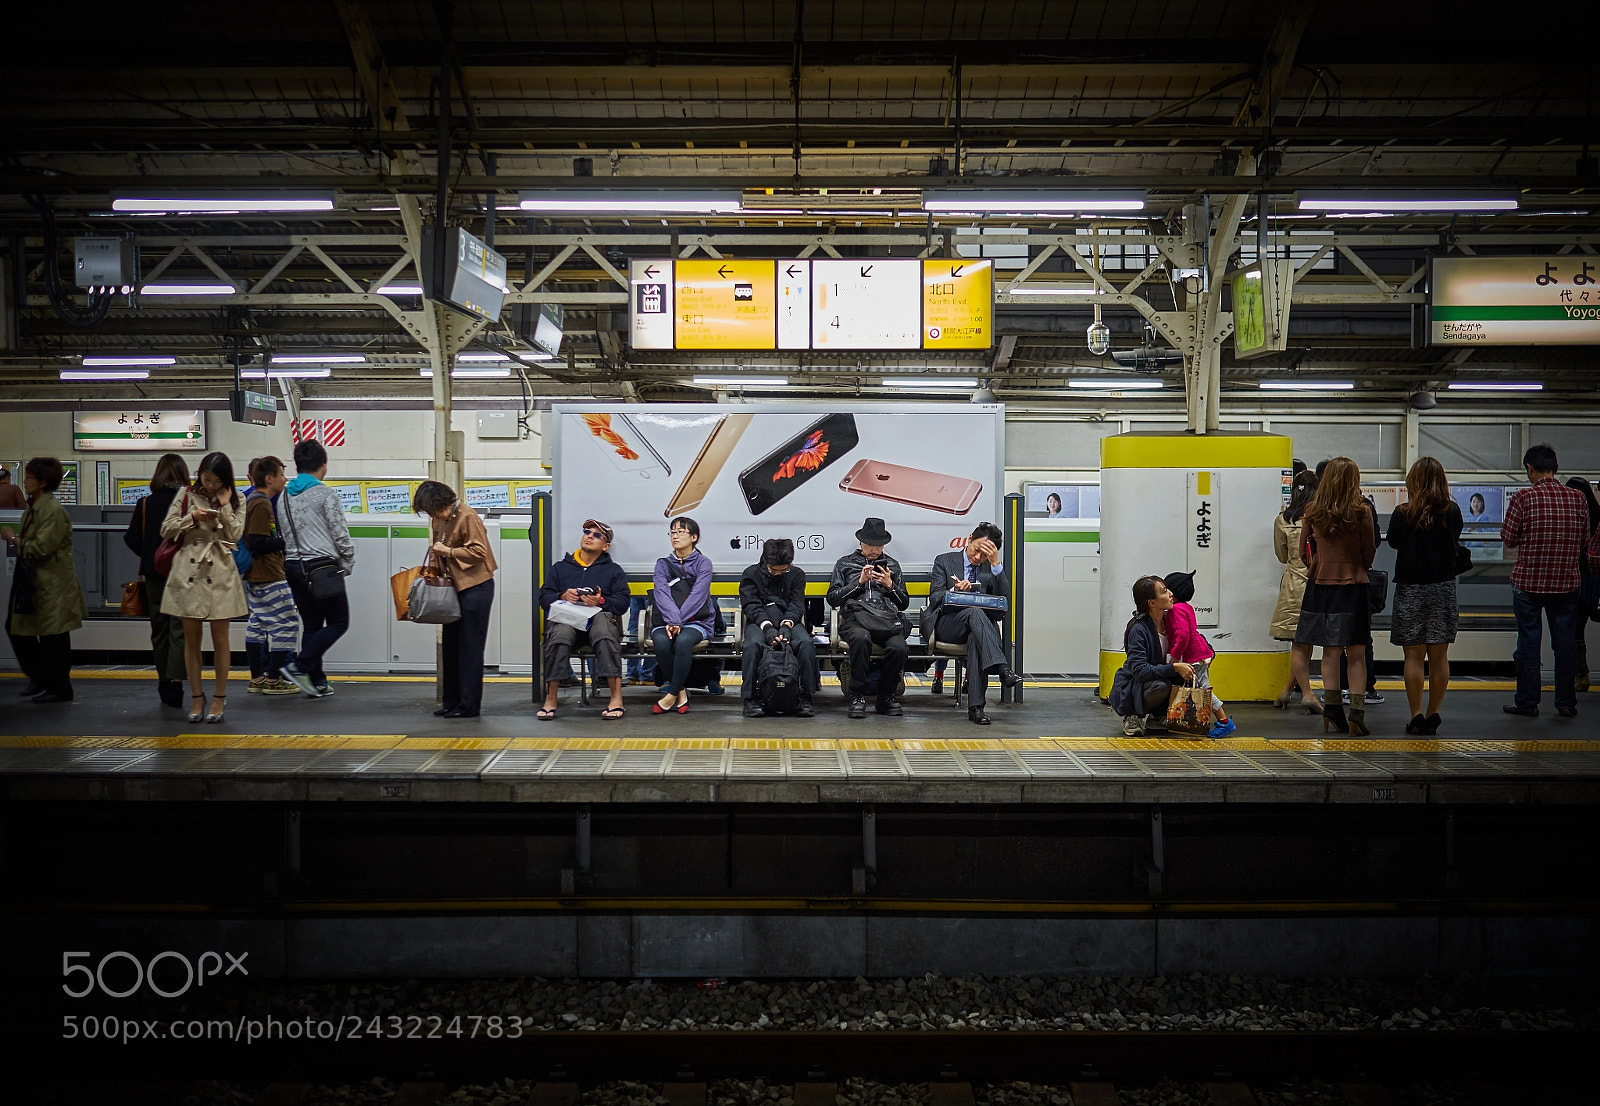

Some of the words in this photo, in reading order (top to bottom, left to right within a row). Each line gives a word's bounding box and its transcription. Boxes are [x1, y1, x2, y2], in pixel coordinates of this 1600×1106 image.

[929, 283, 954, 295] 北口
[830, 315, 840, 329] 4
[1443, 323, 1482, 331] せんだがや
[1442, 332, 1486, 340] Sendagaya
[117, 412, 161, 424] よよぎ
[1196, 501, 1212, 548] よよぎ
[796, 535, 805, 550] 6
